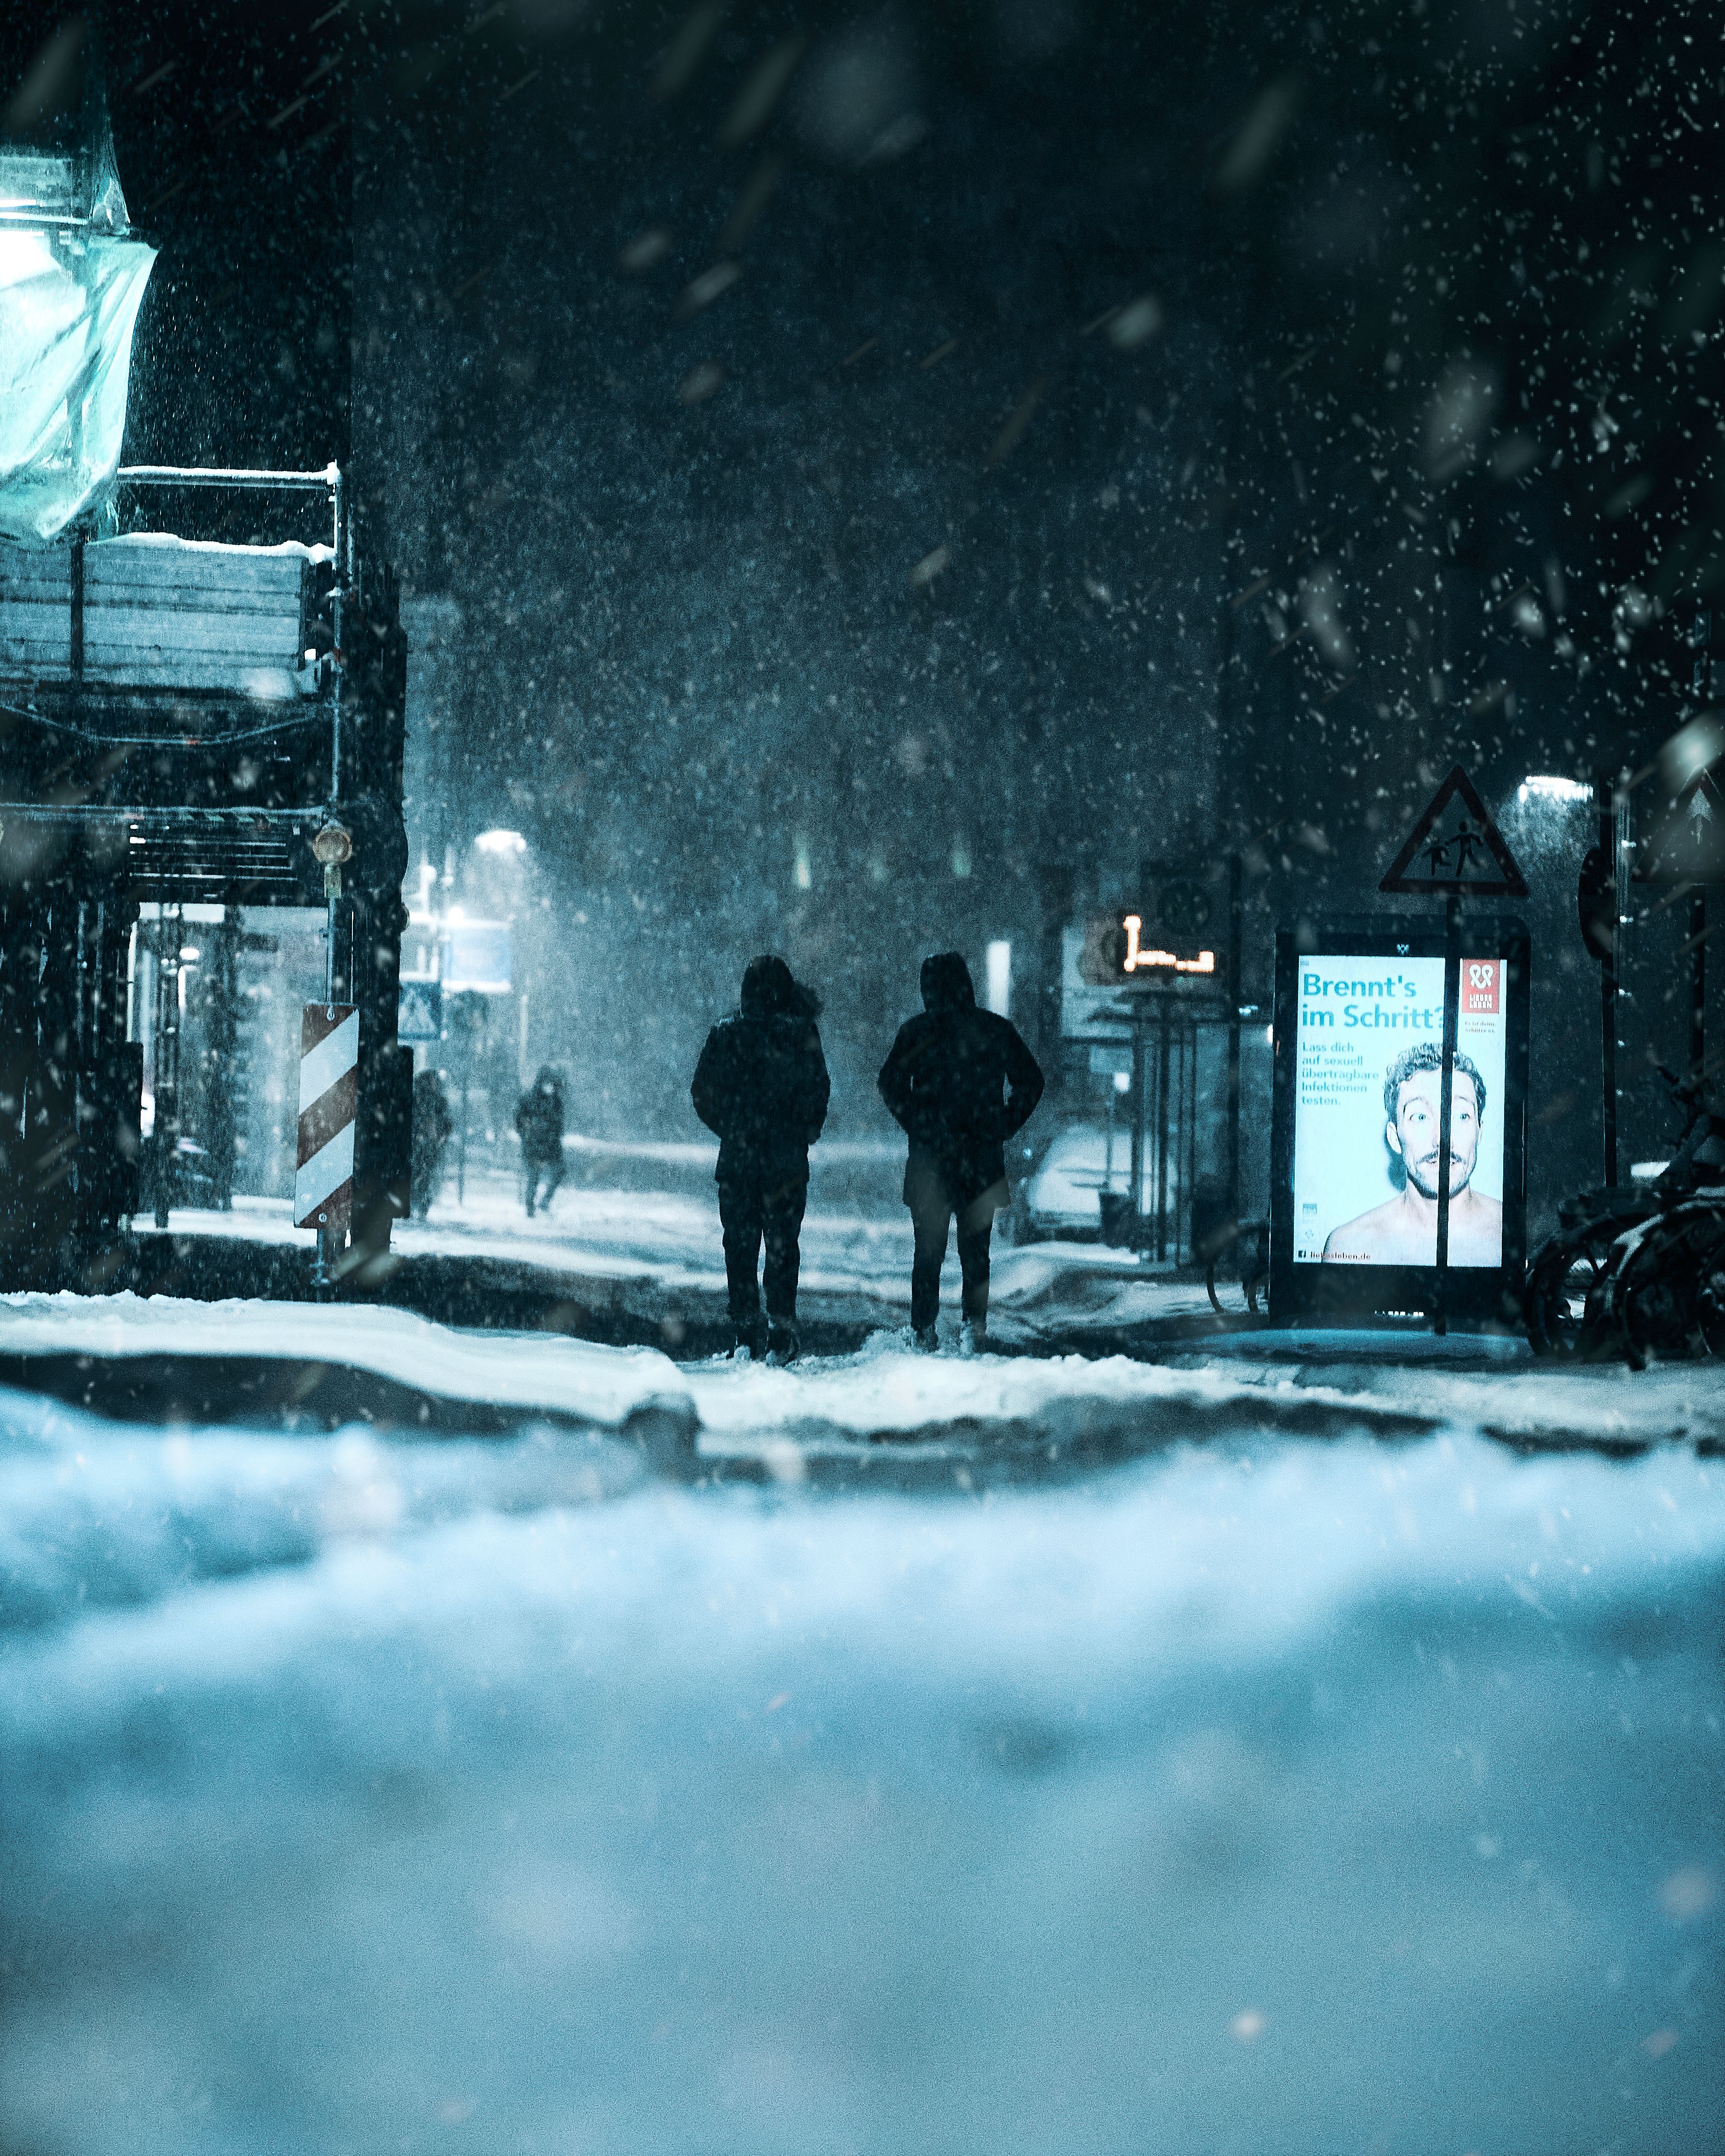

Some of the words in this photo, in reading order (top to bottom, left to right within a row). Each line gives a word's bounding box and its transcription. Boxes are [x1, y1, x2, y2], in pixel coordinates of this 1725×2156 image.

[1304, 973, 1417, 997] Brennt's
[1303, 1003, 1334, 1026] im
[1303, 1041, 1327, 1052] Lass
[1331, 1042, 1354, 1052] dich
[1302, 1055, 1320, 1066] auf
[1324, 1055, 1363, 1066] sexuell
[1302, 1067, 1379, 1082] übertragbare
[1302, 1081, 1367, 1092] Infektionen
[1302, 1096, 1341, 1105] testen.
